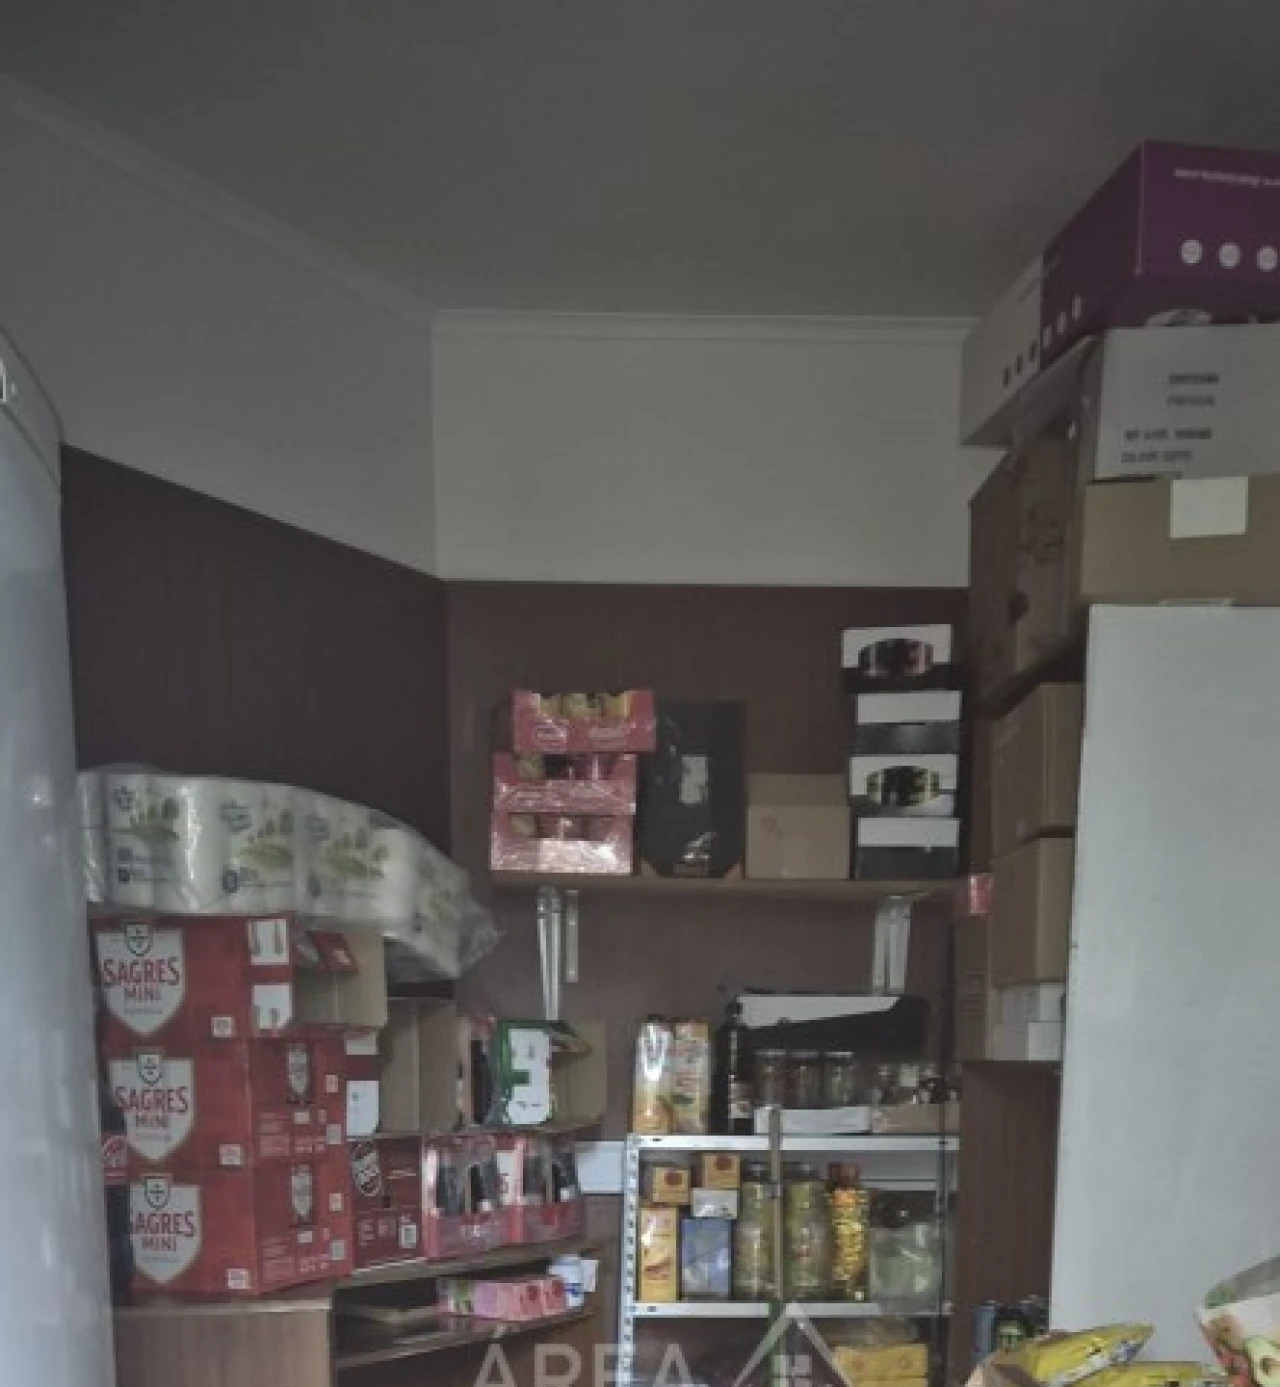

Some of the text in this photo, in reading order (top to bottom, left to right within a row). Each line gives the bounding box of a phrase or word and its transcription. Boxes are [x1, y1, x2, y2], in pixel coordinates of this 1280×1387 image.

[103, 956, 180, 988] SAGRES
[124, 987, 162, 1002] MINI
[116, 1086, 188, 1114] SAGRES
[141, 1236, 177, 1251] MINI
